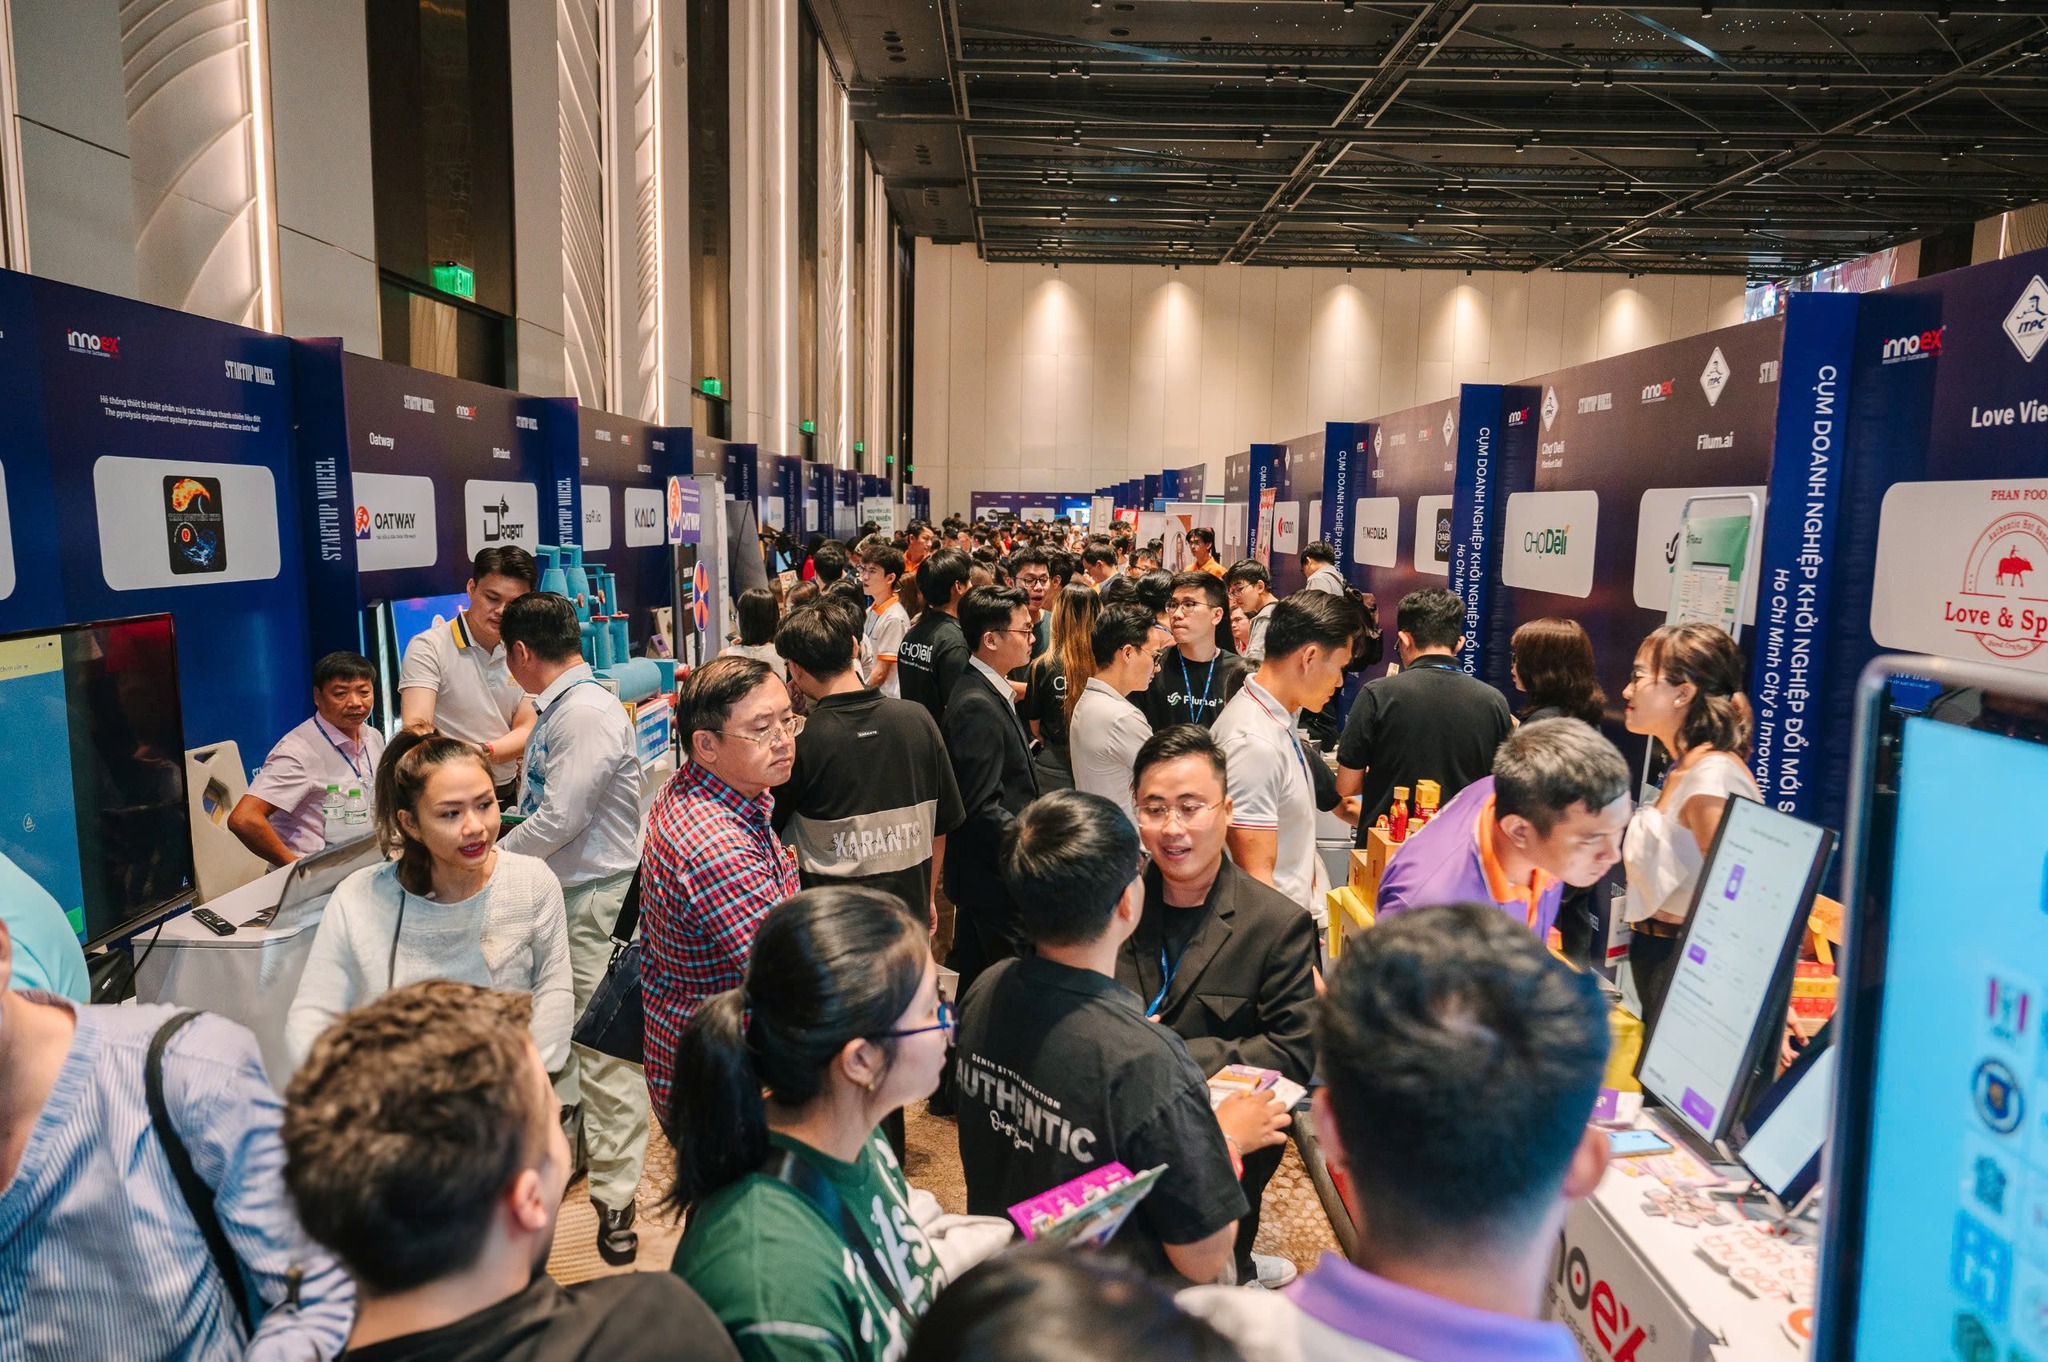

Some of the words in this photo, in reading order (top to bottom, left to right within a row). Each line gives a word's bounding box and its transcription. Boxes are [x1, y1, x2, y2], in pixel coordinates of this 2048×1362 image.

[67, 328, 119, 352] innoex
[1882, 328, 1943, 359] innoex
[2017, 317, 2047, 334] ITPC
[225, 360, 254, 382] STARTUP
[1811, 365, 1837, 415] CỤM
[1971, 406, 2014, 428] Love
[2019, 399, 2048, 424] Vie
[369, 431, 394, 450] Oatway
[1476, 427, 1491, 456] CỤM
[1697, 431, 1734, 451] Filum.ai
[1807, 420, 1833, 497] DOANH
[315, 457, 338, 500] WHEEL
[1336, 450, 1347, 471] CỤM
[1336, 473, 1346, 504] DOANH
[1474, 458, 1489, 503] DOANH
[1991, 490, 2020, 501] PHAN
[2023, 489, 2048, 501] FOO
[319, 504, 341, 561] STARTUP
[374, 512, 416, 529] OATWAY
[1334, 505, 1345, 536] NGHIỆP
[1469, 505, 1486, 549] NGHIỆP
[1456, 543, 1466, 557] Ho
[1796, 502, 1825, 579] NGHIỆP
[1468, 552, 1484, 583] KHỞI
[1773, 567, 1790, 592] Ho
[1463, 584, 1480, 628] NGHIỆP
[1770, 595, 1788, 624] Chi
[1793, 583, 1819, 634] KHỞI
[1944, 601, 1990, 626] Love
[1998, 606, 2014, 629] &
[2021, 609, 2048, 638] Sp
[1765, 626, 1785, 669] Minh
[1783, 637, 1811, 714] NGHIỆP
[1759, 671, 1781, 719] City's
[1782, 717, 1810, 754] ĐỔI
[1756, 721, 1776, 804] Innovativ
[1778, 757, 1803, 795] MỚI
[832, 820, 921, 858] KARANTS
[955, 1056, 1097, 1164] AUTHENTIC
[1558, 1229, 1648, 1362] oex
